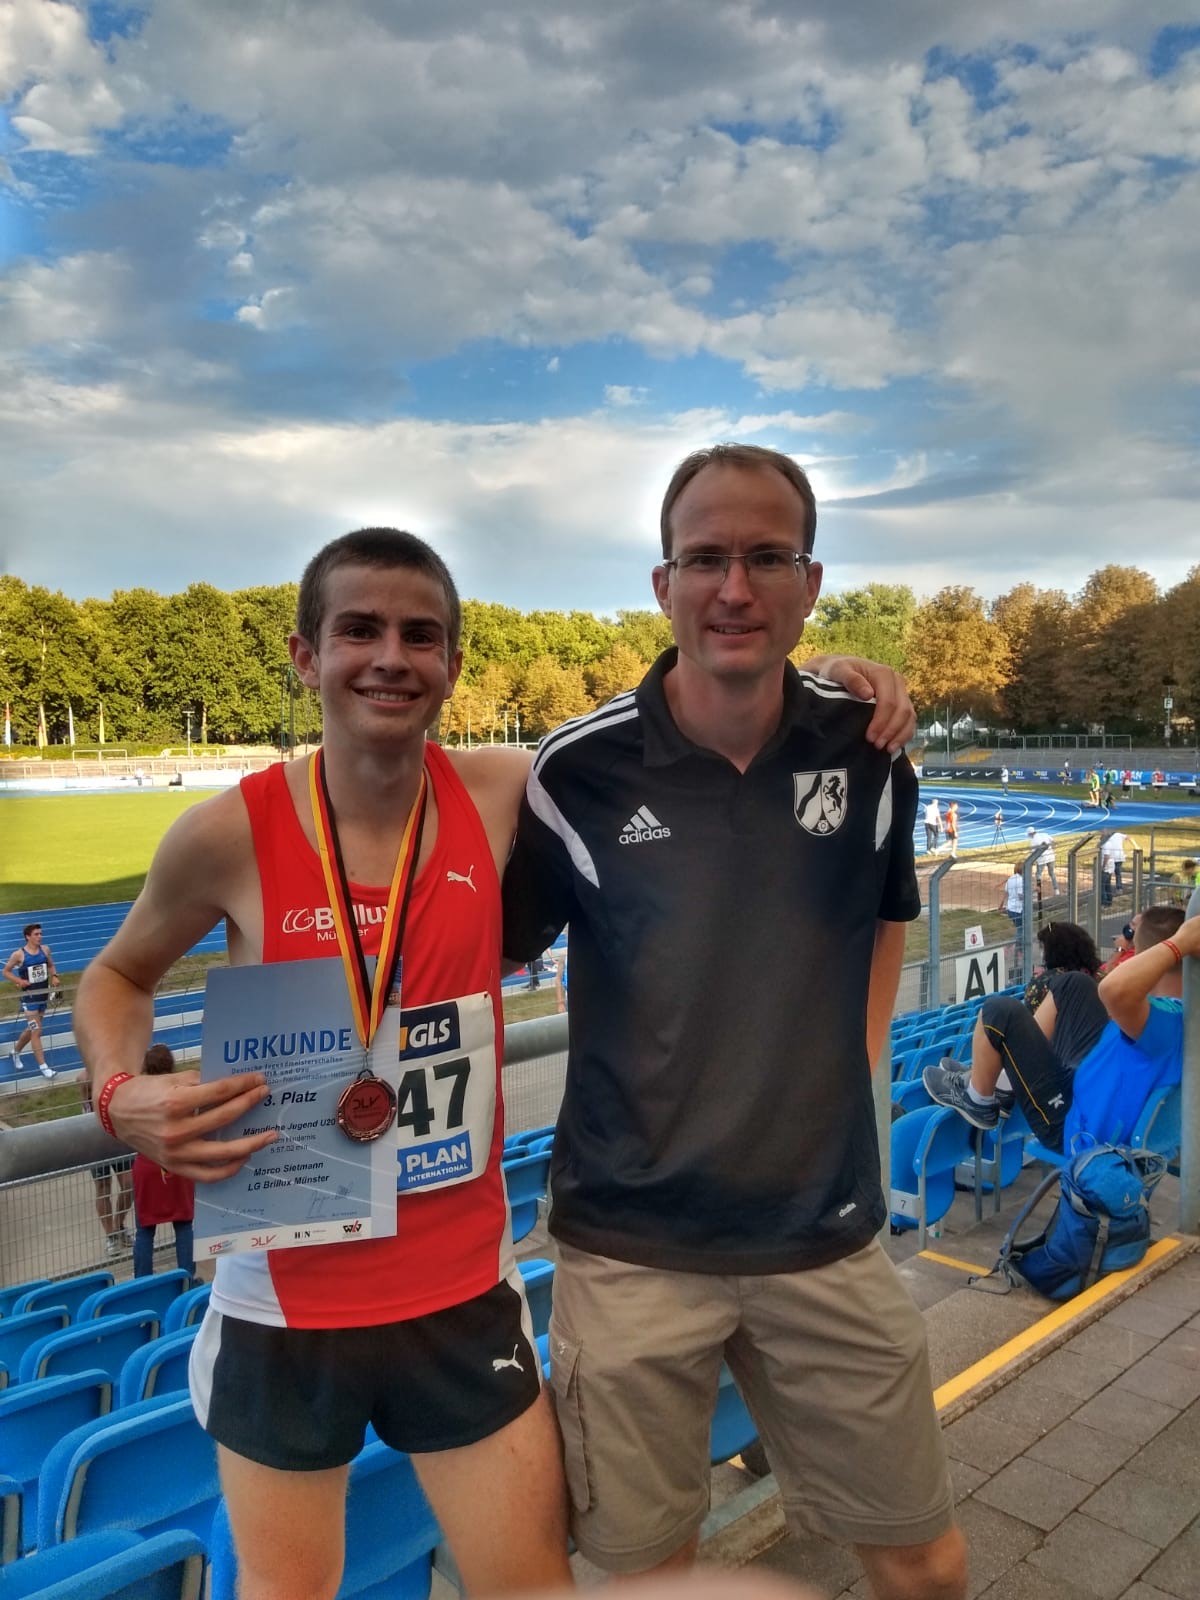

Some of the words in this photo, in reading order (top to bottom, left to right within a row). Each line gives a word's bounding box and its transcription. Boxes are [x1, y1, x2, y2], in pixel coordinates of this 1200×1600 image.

[618, 827, 672, 844] adidas
[316, 928, 369, 942] Müer
[964, 952, 999, 1001] A1
[408, 1018, 451, 1049] GLS
[223, 1028, 353, 1064] URKUNDE
[263, 1094, 276, 1107] 3.
[281, 1090, 318, 1105] Platz
[287, 1119, 318, 1132] Jugend
[320, 1117, 336, 1128] U20
[406, 1141, 468, 1173] PLAN
[253, 1165, 281, 1177] Marco
[283, 1160, 324, 1173] Sietmann
[408, 1162, 469, 1183] INTERNATIONAL
[247, 1182, 261, 1192] LG
[263, 1178, 292, 1190] Brillux
[294, 1173, 330, 1185] Münster
[900, 1199, 906, 1209] 7
